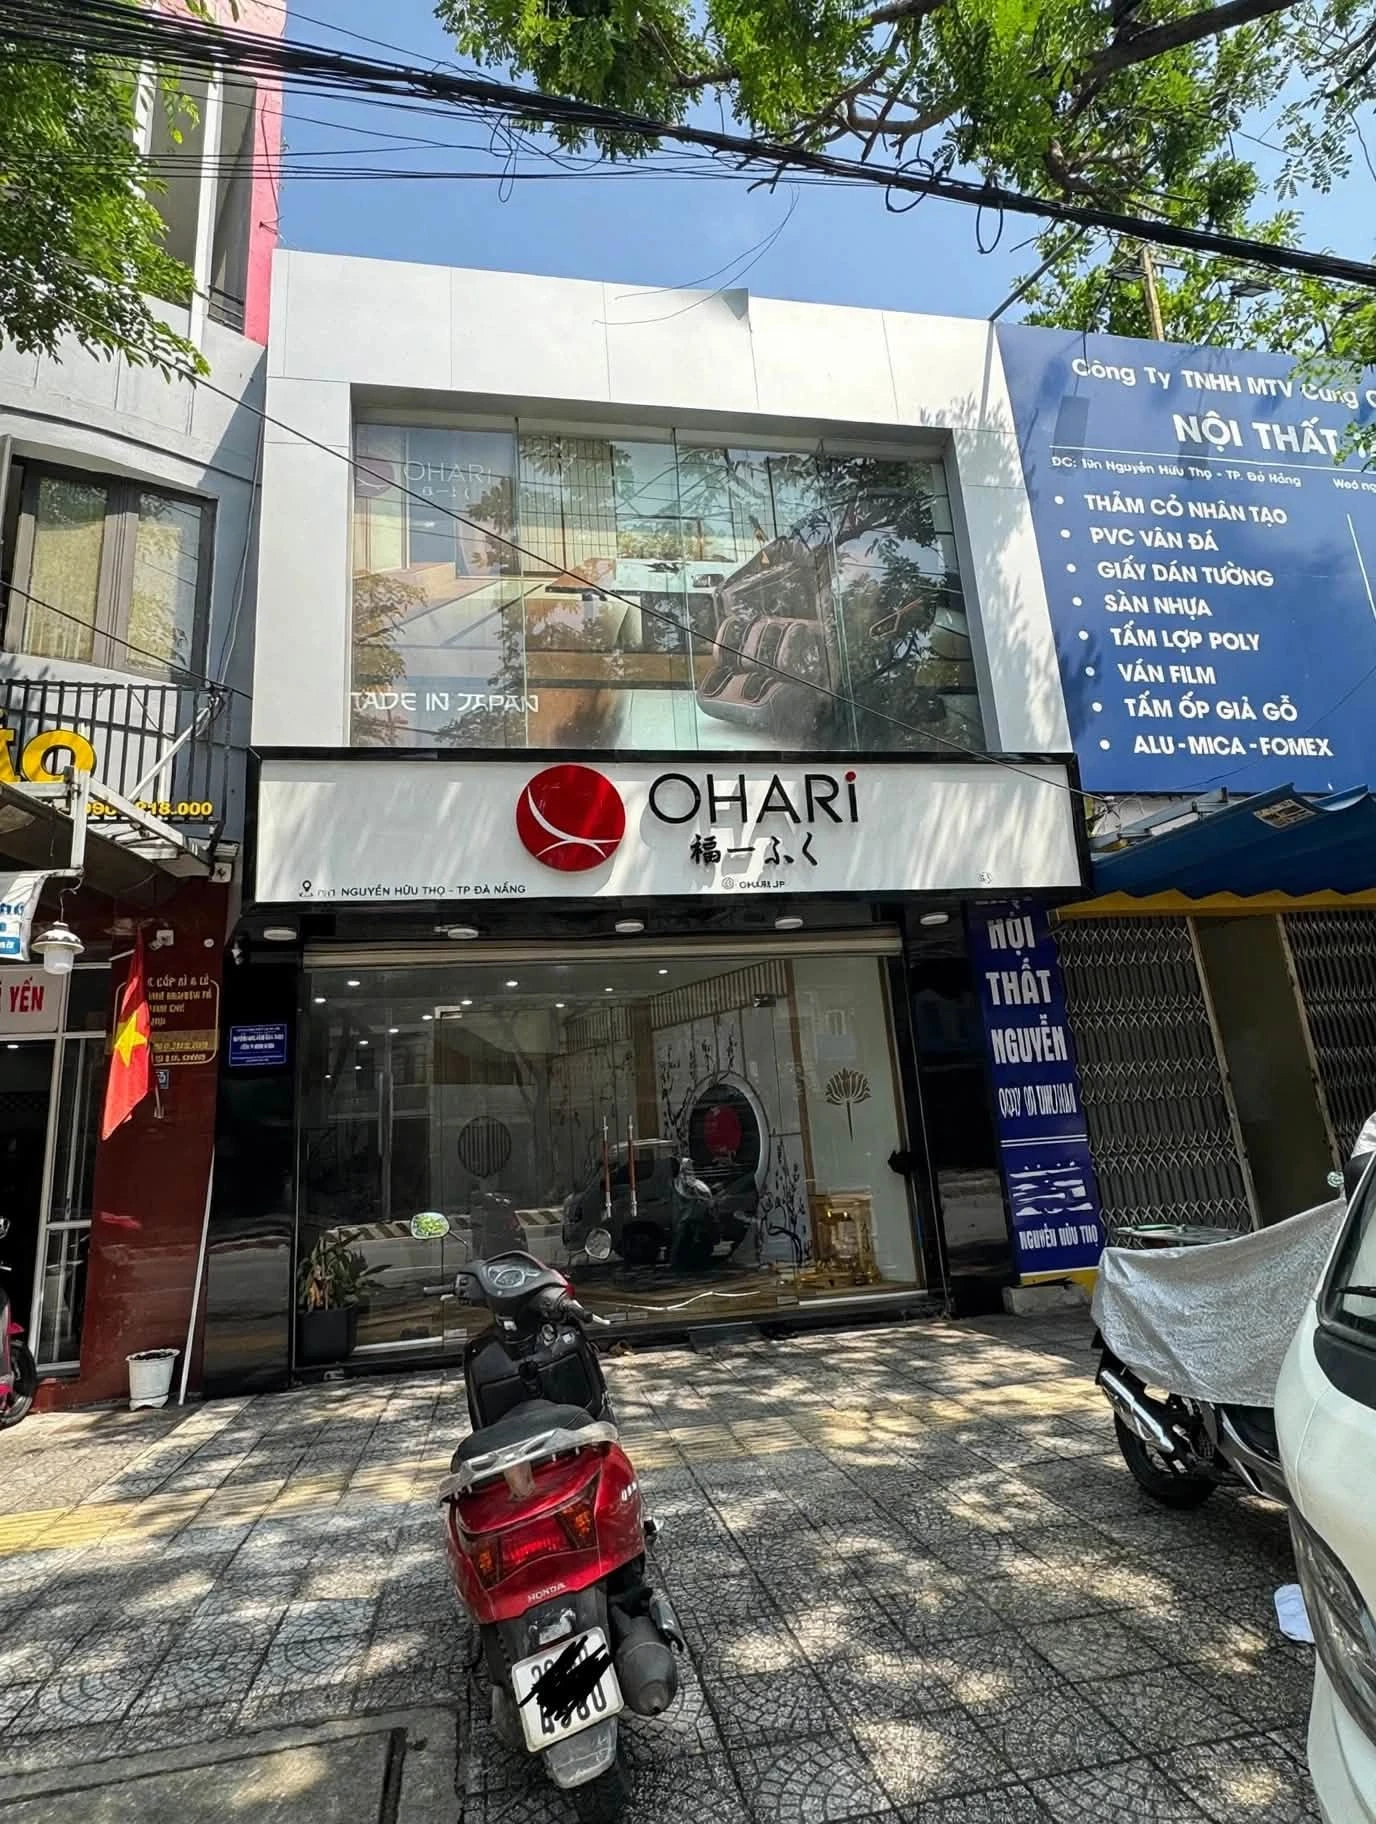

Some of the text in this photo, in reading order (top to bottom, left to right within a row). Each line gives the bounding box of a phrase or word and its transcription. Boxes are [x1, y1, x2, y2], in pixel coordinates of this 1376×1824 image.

[1072, 358, 1136, 386] Công
[1144, 367, 1170, 389] Ty
[1181, 370, 1242, 393] TNHH
[1248, 377, 1293, 398] MTV
[1172, 411, 1243, 452] NỘI
[1251, 417, 1338, 456] THẤT
[1084, 491, 1288, 527] THẢM CỎ NHÂN TẠO
[1089, 527, 1219, 551] PVC VÂN ĐÁ
[1098, 555, 1274, 587] GIẤY DÁN TƯỜNG
[1104, 590, 1213, 620] SÀN NHỰA
[1110, 620, 1260, 653] TẤM LỢP POLY
[1117, 659, 1217, 684] VÁN FILM
[426, 693, 448, 711] IN
[457, 693, 539, 712] JAPAN
[1124, 690, 1298, 721] TẤM ỐP GIẢ GỖ
[690, 832, 818, 866] 福一ふく
[395, 884, 418, 896] HỮU
[422, 886, 446, 897] THỌ
[457, 885, 470, 895] TP
[474, 883, 490, 895] ĐÀ
[10, 976, 45, 1013] YẾN
[985, 957, 1052, 1005] THẤT
[528, 1582, 566, 1603] HONDA
